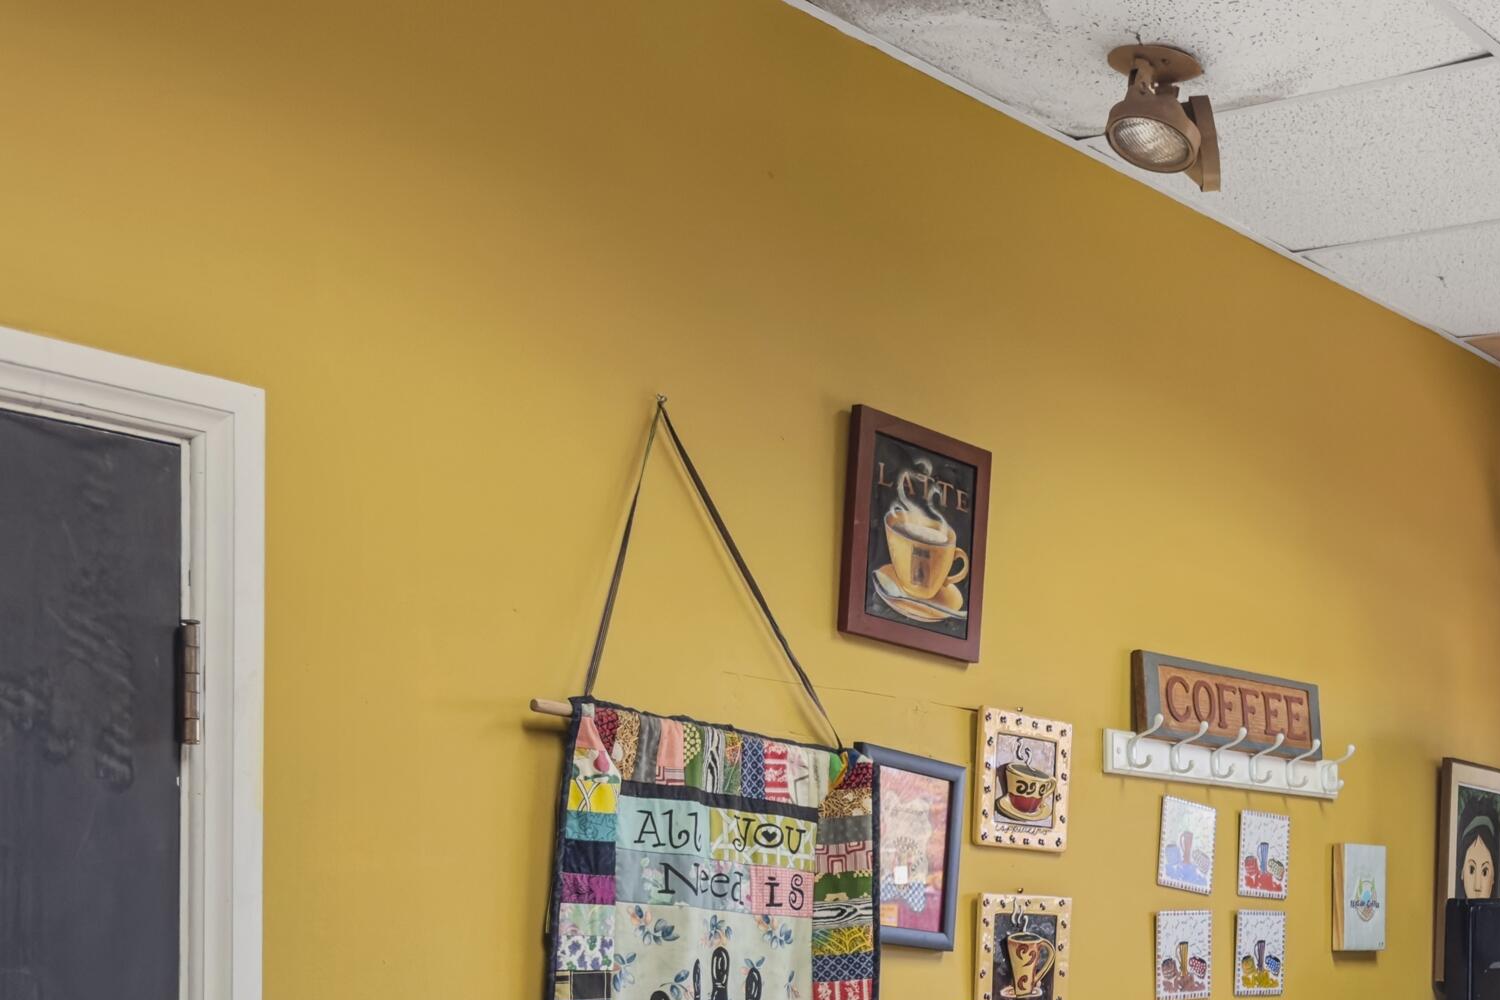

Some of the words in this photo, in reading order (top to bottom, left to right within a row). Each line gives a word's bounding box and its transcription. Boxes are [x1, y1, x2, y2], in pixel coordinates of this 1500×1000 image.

[878, 462, 969, 513] LATTE
[1165, 676, 1309, 740] COFFEE
[634, 809, 702, 852] All
[658, 862, 745, 906] Need
